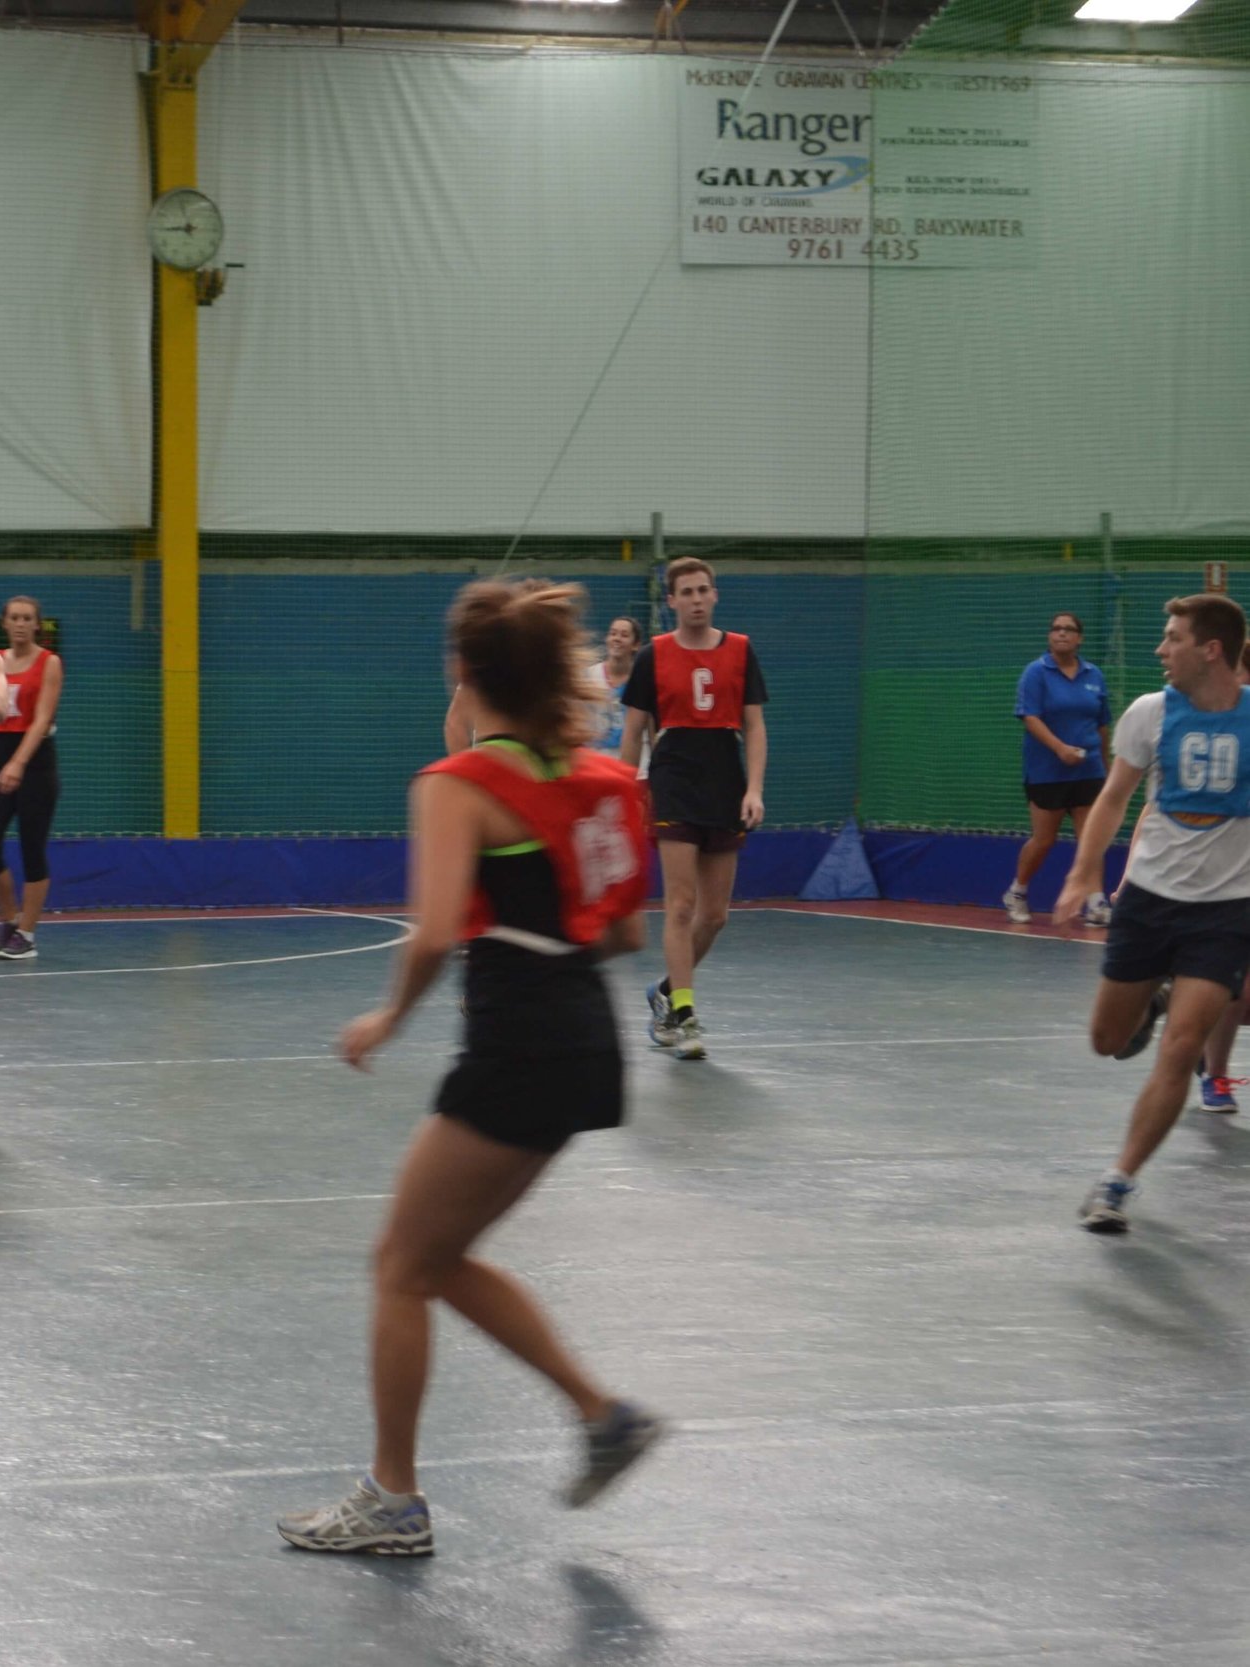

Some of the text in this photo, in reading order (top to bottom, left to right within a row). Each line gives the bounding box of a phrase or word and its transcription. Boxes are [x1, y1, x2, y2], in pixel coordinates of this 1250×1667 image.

[717, 99, 873, 156] Ranger
[696, 167, 835, 187] GALAXY
[742, 197, 756, 207] OF
[692, 215, 727, 233] 140
[738, 216, 862, 235] CANTERBURY
[914, 218, 1024, 237] BAYSWATER
[788, 239, 919, 260] 9761 4435
[691, 668, 715, 711] C
[1178, 731, 1240, 793] GD
